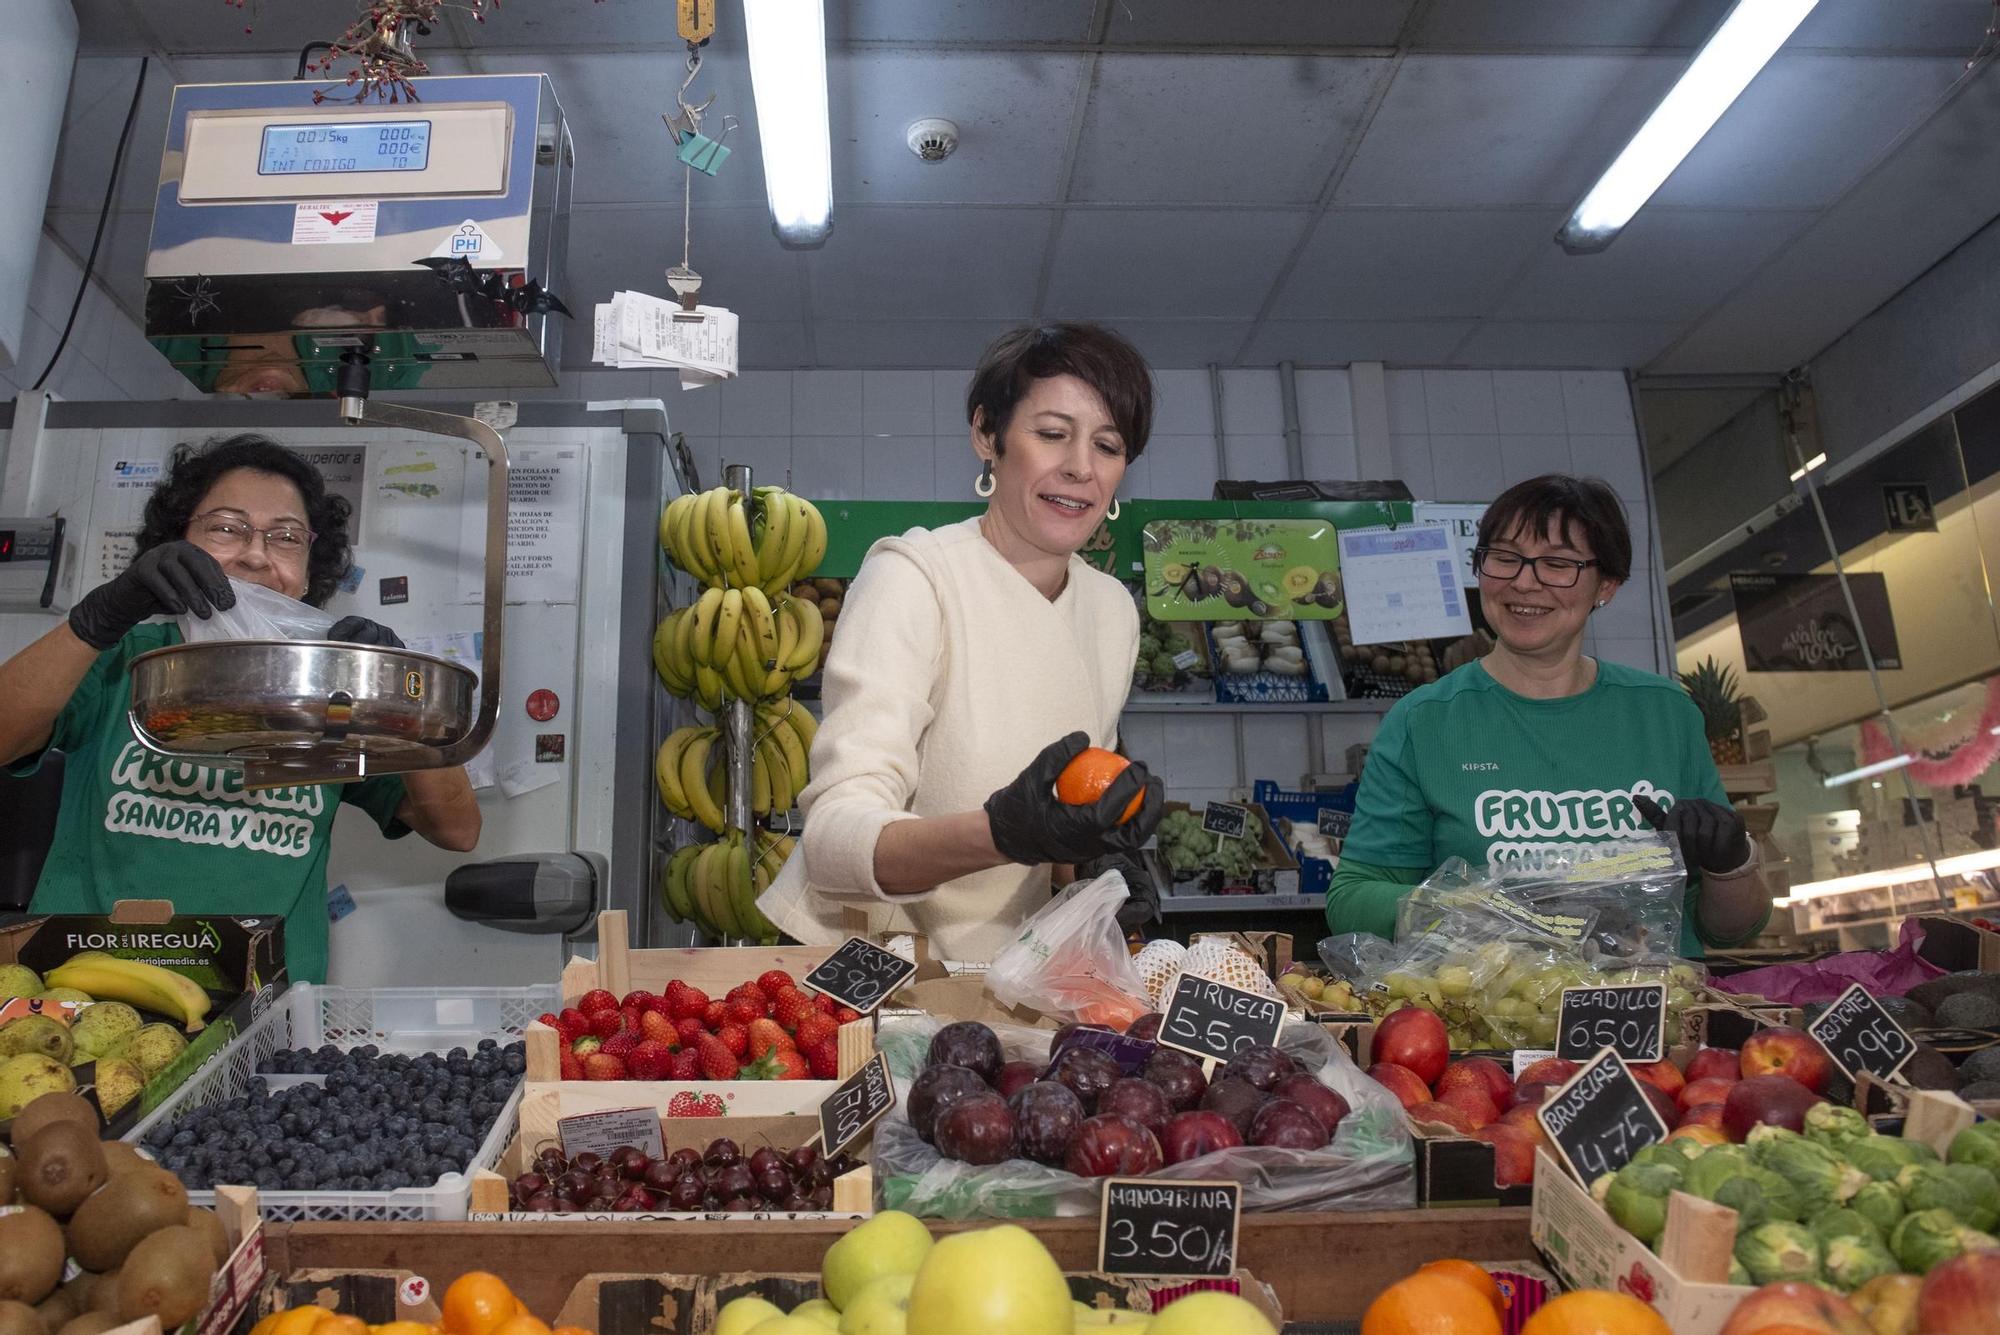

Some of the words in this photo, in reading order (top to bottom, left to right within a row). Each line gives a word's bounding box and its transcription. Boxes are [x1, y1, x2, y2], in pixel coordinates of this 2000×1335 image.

[456, 239, 477, 250] PH
[353, 454, 362, 464] a
[1462, 762, 1500, 771] KIPSTA
[113, 799, 220, 838] SANDRA
[230, 814, 248, 841] Y
[251, 819, 308, 850] JOSE
[67, 933, 119, 949] FLOR
[121, 934, 129, 948] DEL
[131, 933, 215, 949] IREGUA
[841, 939, 904, 979] FRESA
[1178, 978, 1276, 1025] CIRUELA
[1563, 989, 1661, 1011] PELADILLO
[1815, 990, 1872, 1043] AGUACATE
[1545, 1058, 1620, 1137] BRUSELAS
[1110, 1188, 1233, 1210] MANDARINA
